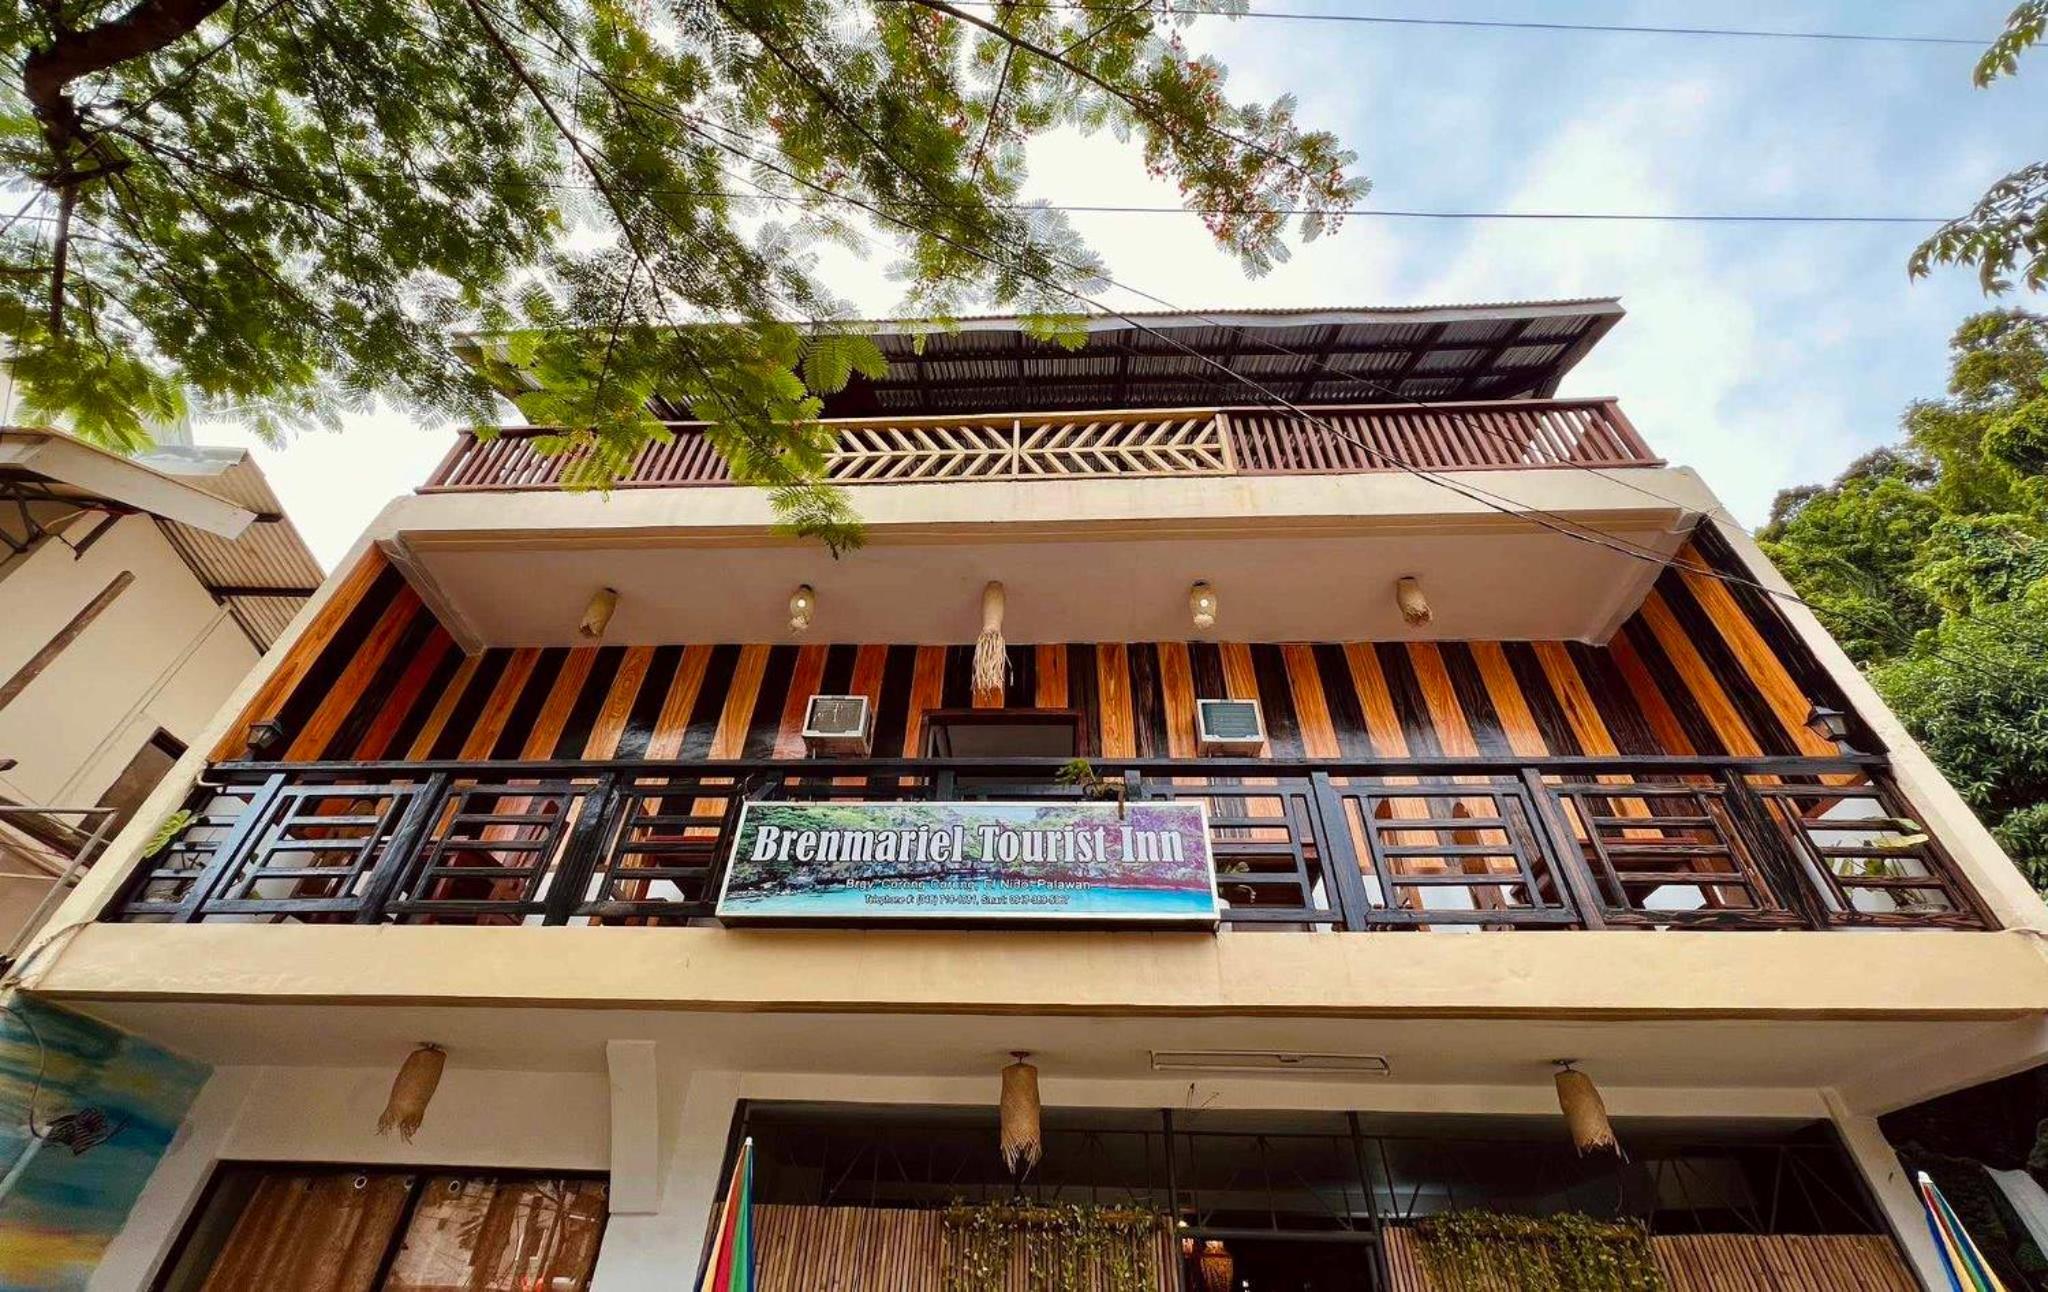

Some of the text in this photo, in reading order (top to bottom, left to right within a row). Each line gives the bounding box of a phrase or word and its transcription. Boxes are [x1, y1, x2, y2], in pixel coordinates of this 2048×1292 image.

[750, 824, 1186, 863] Brenmariel Tourist Inn
[1037, 879, 1090, 890] Palawan
